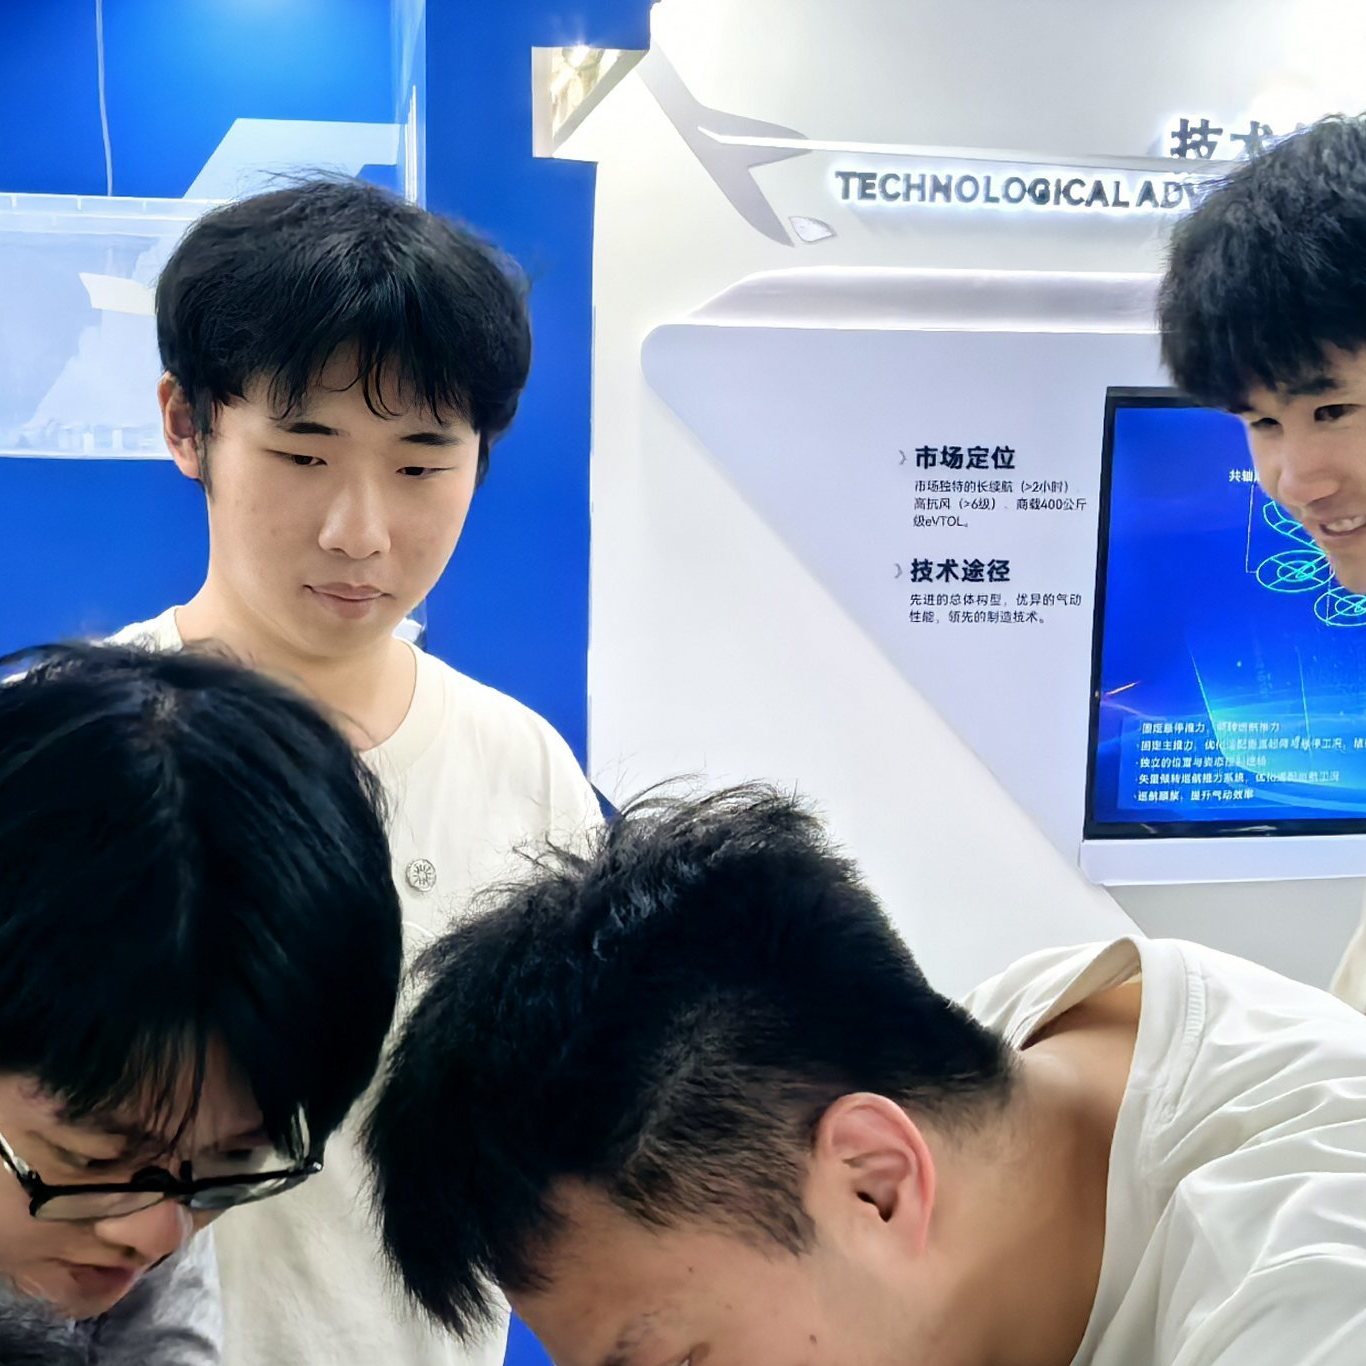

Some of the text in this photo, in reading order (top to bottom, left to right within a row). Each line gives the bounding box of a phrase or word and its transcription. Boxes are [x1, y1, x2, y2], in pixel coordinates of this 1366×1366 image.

[835, 170, 1130, 209] TECHNOLOGICAL
[915, 445, 1016, 470] 市场定位
[910, 558, 1011, 583] 技术途径
